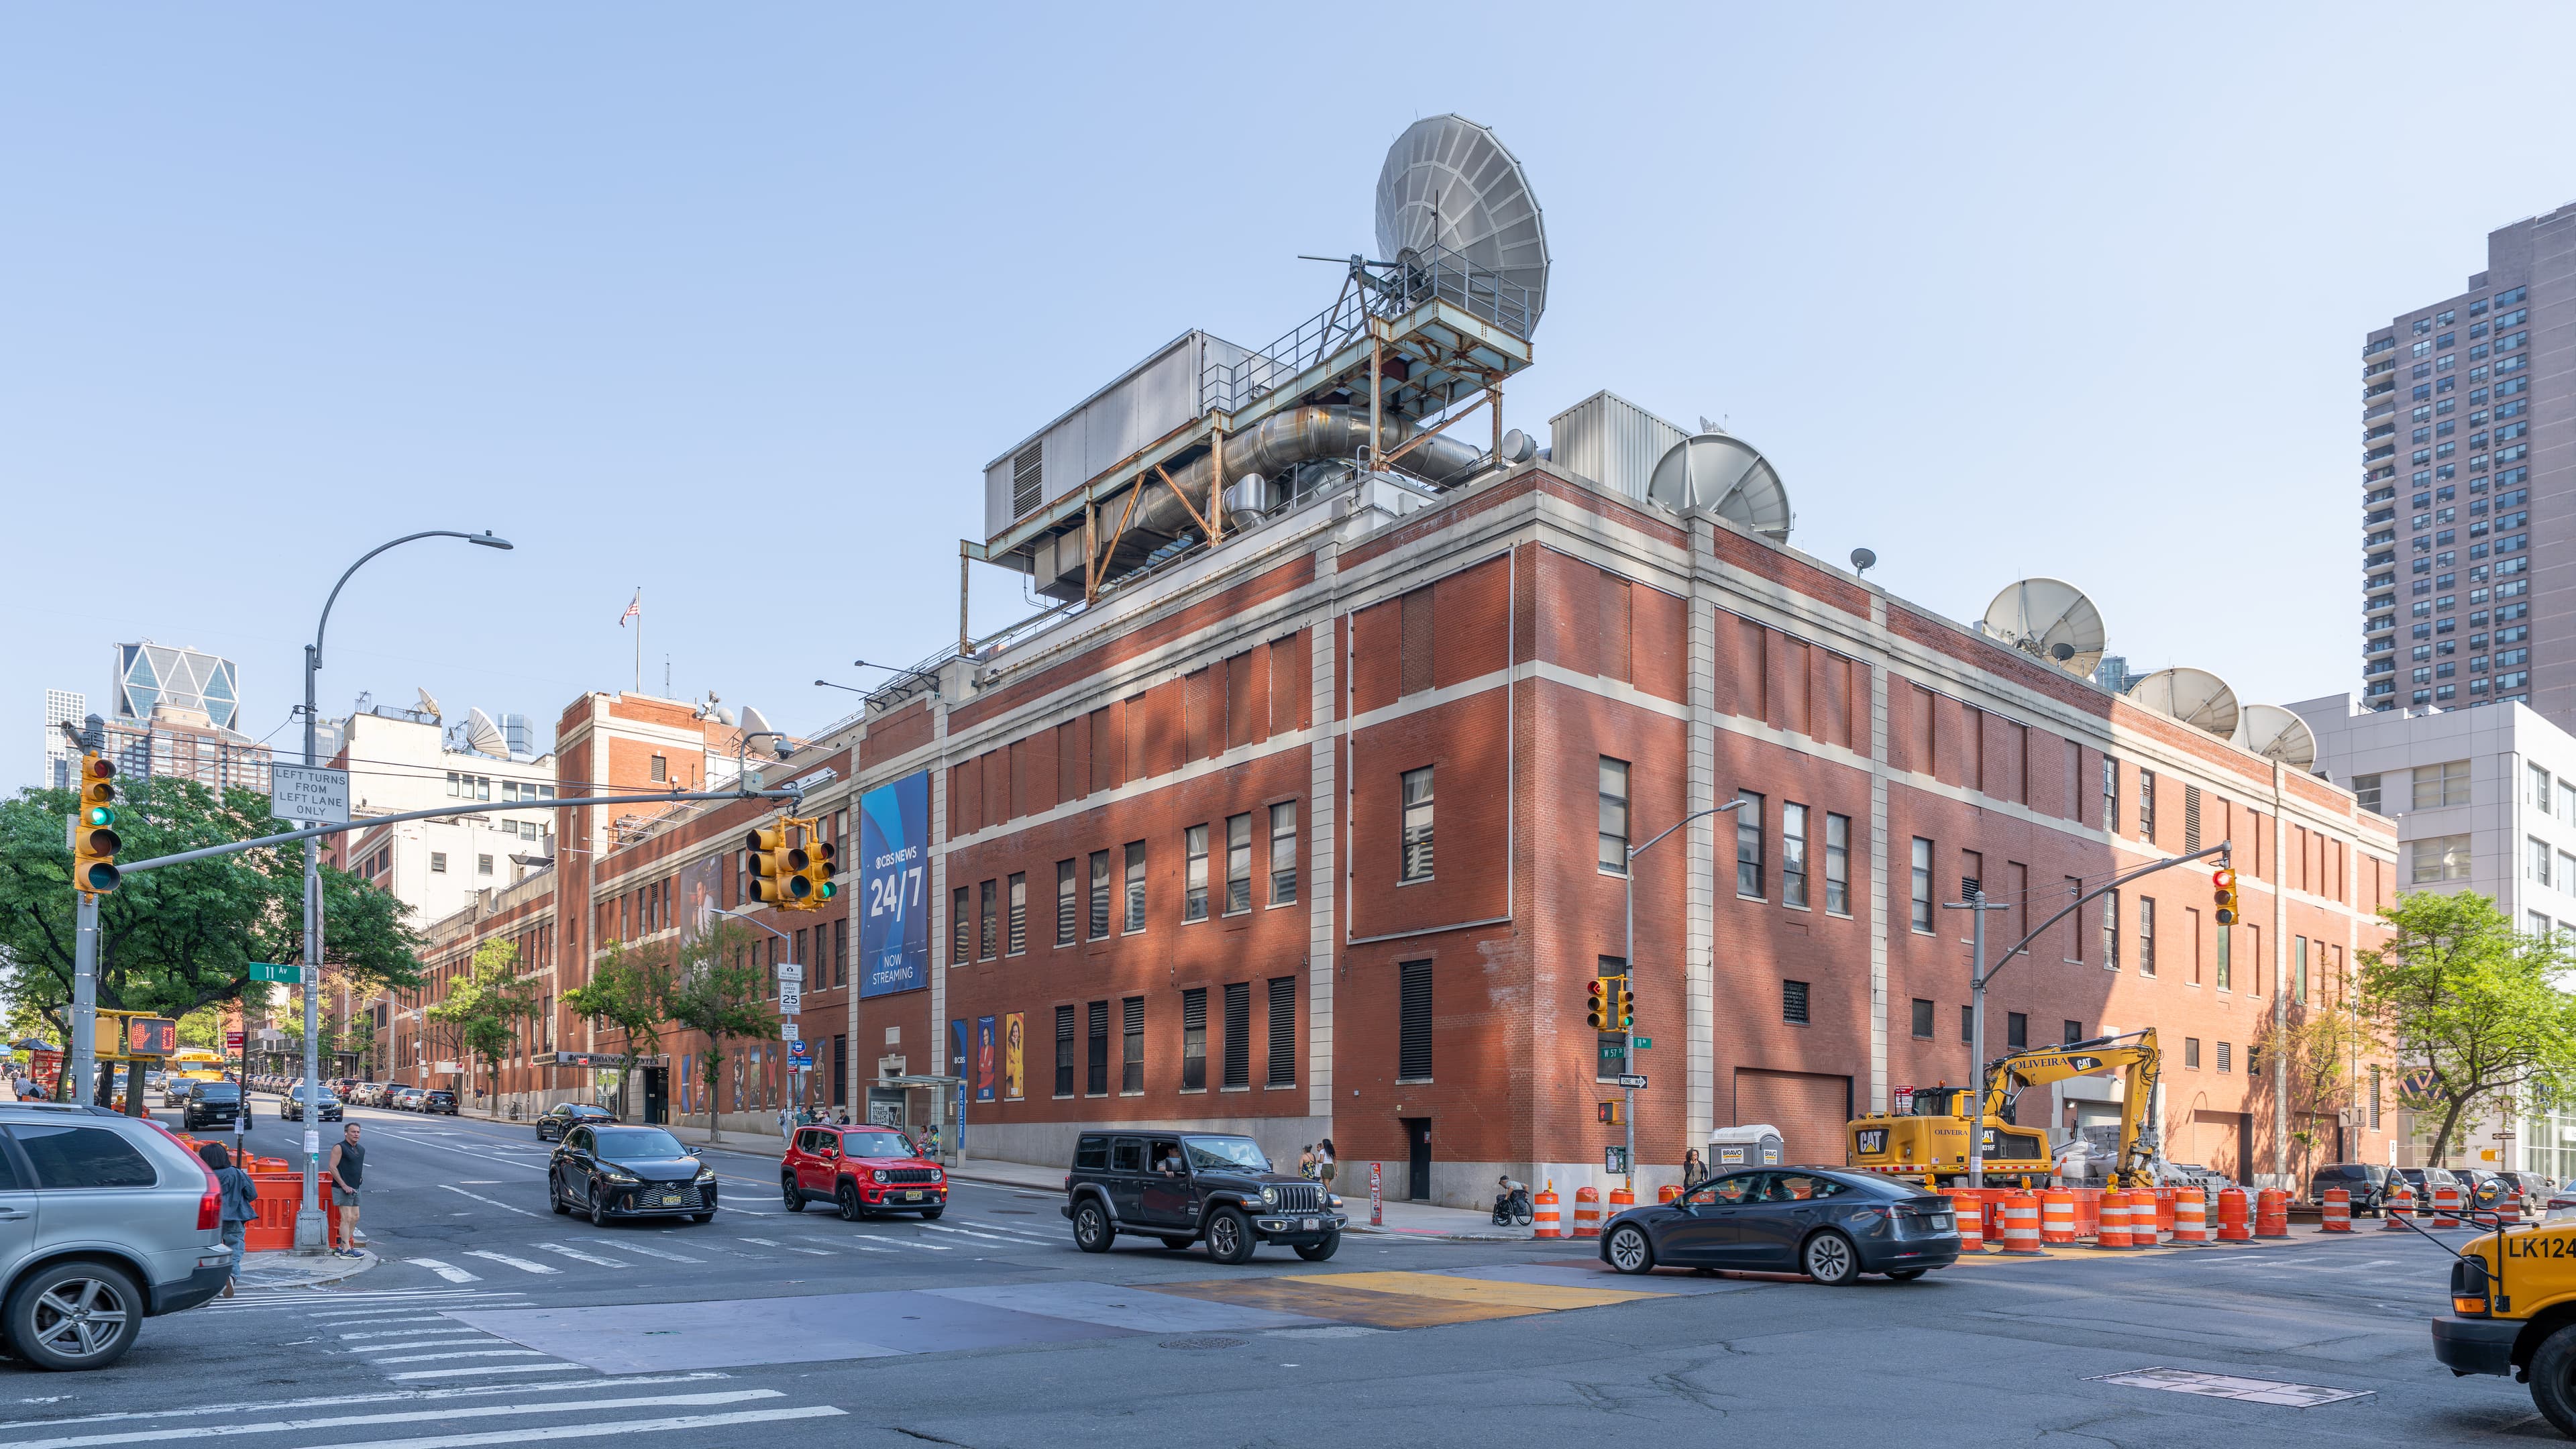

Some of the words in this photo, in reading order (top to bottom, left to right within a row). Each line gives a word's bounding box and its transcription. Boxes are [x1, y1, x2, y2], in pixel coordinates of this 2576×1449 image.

[276, 769, 303, 780] LEFT
[309, 773, 345, 785] TURNS
[296, 783, 327, 794] FROM
[280, 792, 307, 803] LEFT
[312, 796, 342, 807] LANE
[297, 806, 326, 816] ONLY
[881, 853, 895, 867] CBS
[896, 845, 917, 863] NEWS
[871, 866, 922, 922] 24/7
[885, 953, 902, 967] NOW
[266, 966, 274, 979] 11
[279, 966, 287, 975] Av
[873, 966, 913, 985] STREAMING
[783, 995, 798, 1004] 25
[1638, 1038, 1642, 1047] 11
[957, 1056, 965, 1064] CBS
[1604, 1049, 1609, 1058] W
[1610, 1049, 1617, 1057] 57
[2014, 1057, 2068, 1069] OLIVEIRA
[2076, 1057, 2092, 1071] CAT
[1860, 1131, 1882, 1152] CAT
[1982, 1130, 1995, 1143] AT
